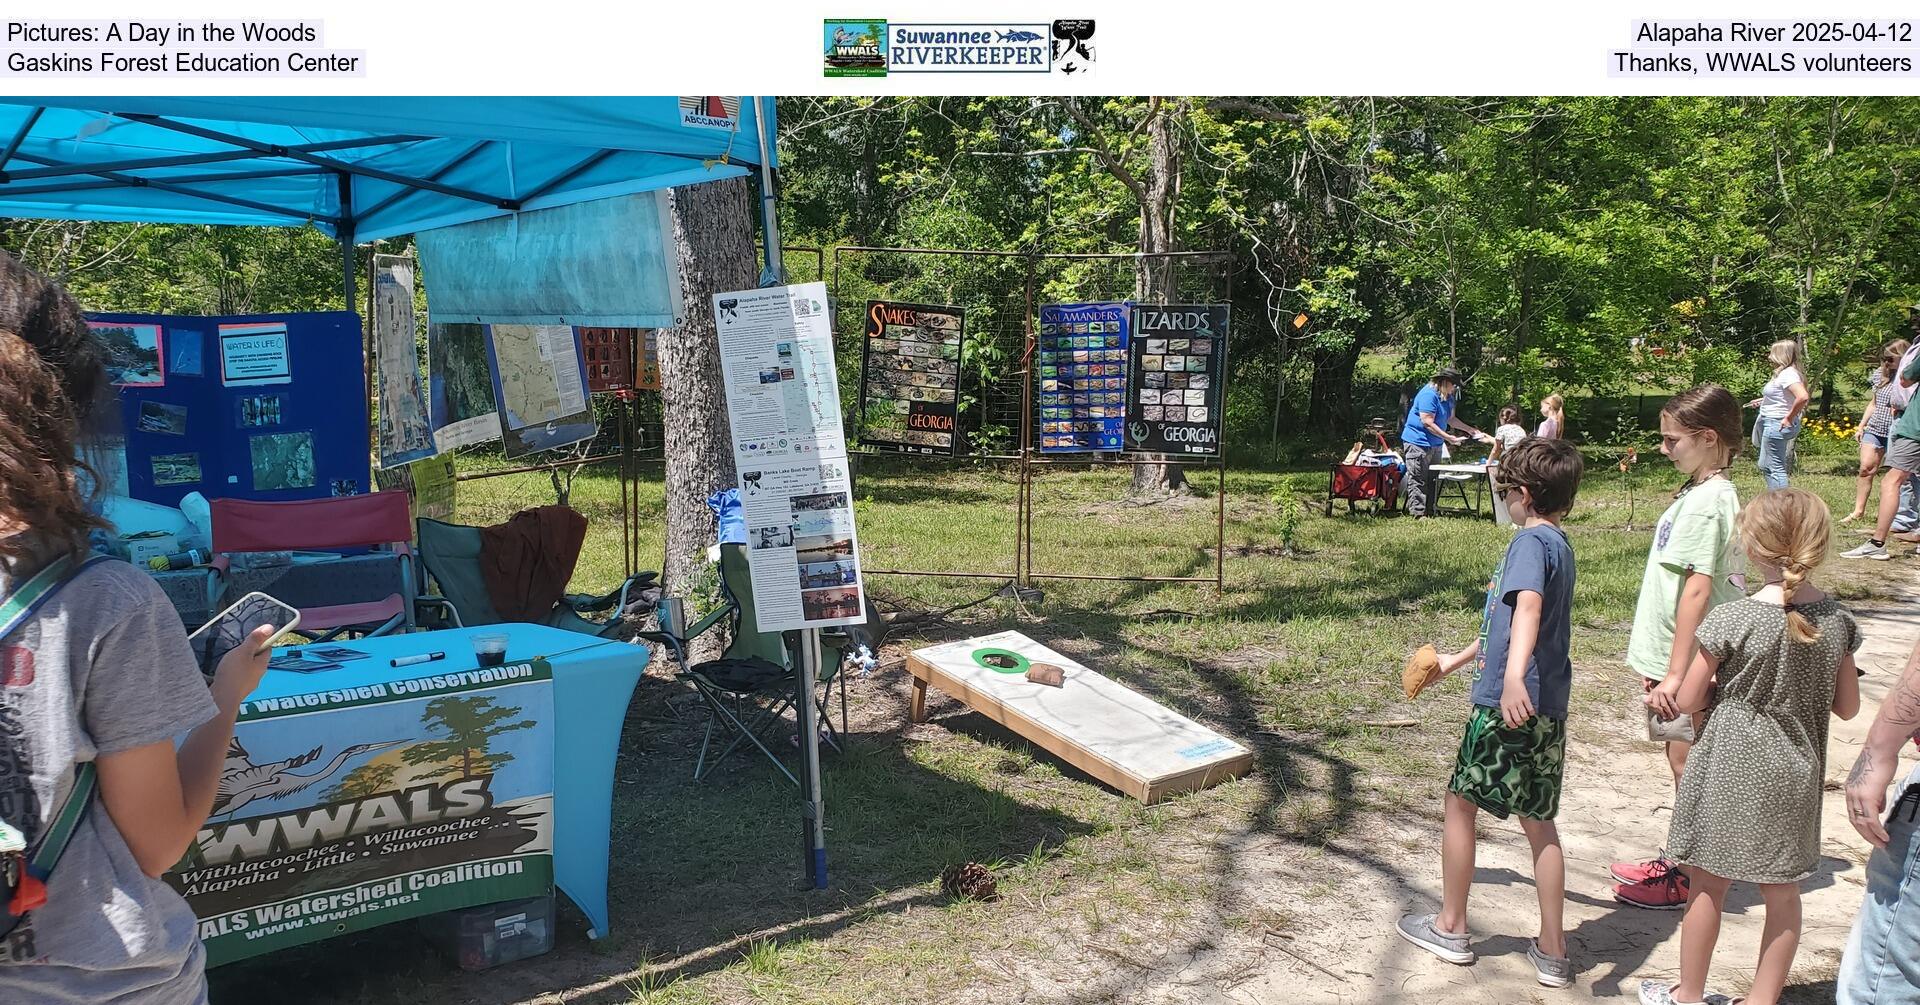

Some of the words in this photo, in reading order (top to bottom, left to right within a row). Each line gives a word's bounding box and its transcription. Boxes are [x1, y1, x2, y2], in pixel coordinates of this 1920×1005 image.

[684, 115, 736, 129] ABCCANOPY
[868, 303, 916, 338] SNAKES
[1044, 311, 1119, 323] SALAMANDERS
[1132, 308, 1211, 339] LIZARDS
[909, 413, 954, 430] GEORGIA
[1163, 426, 1217, 443] GEORGIA
[253, 682, 388, 713] Watershed
[390, 663, 534, 696] Conservation
[195, 779, 486, 865] WWALS
[180, 842, 340, 885] Withlacoochee
[182, 870, 280, 898] Alapaha
[302, 851, 357, 873] Little
[379, 829, 480, 856] Suwannee
[197, 912, 250, 941] ALS
[253, 877, 403, 926] Watershed
[407, 859, 524, 891] Coalition
[244, 891, 422, 941] www.wwals.net
